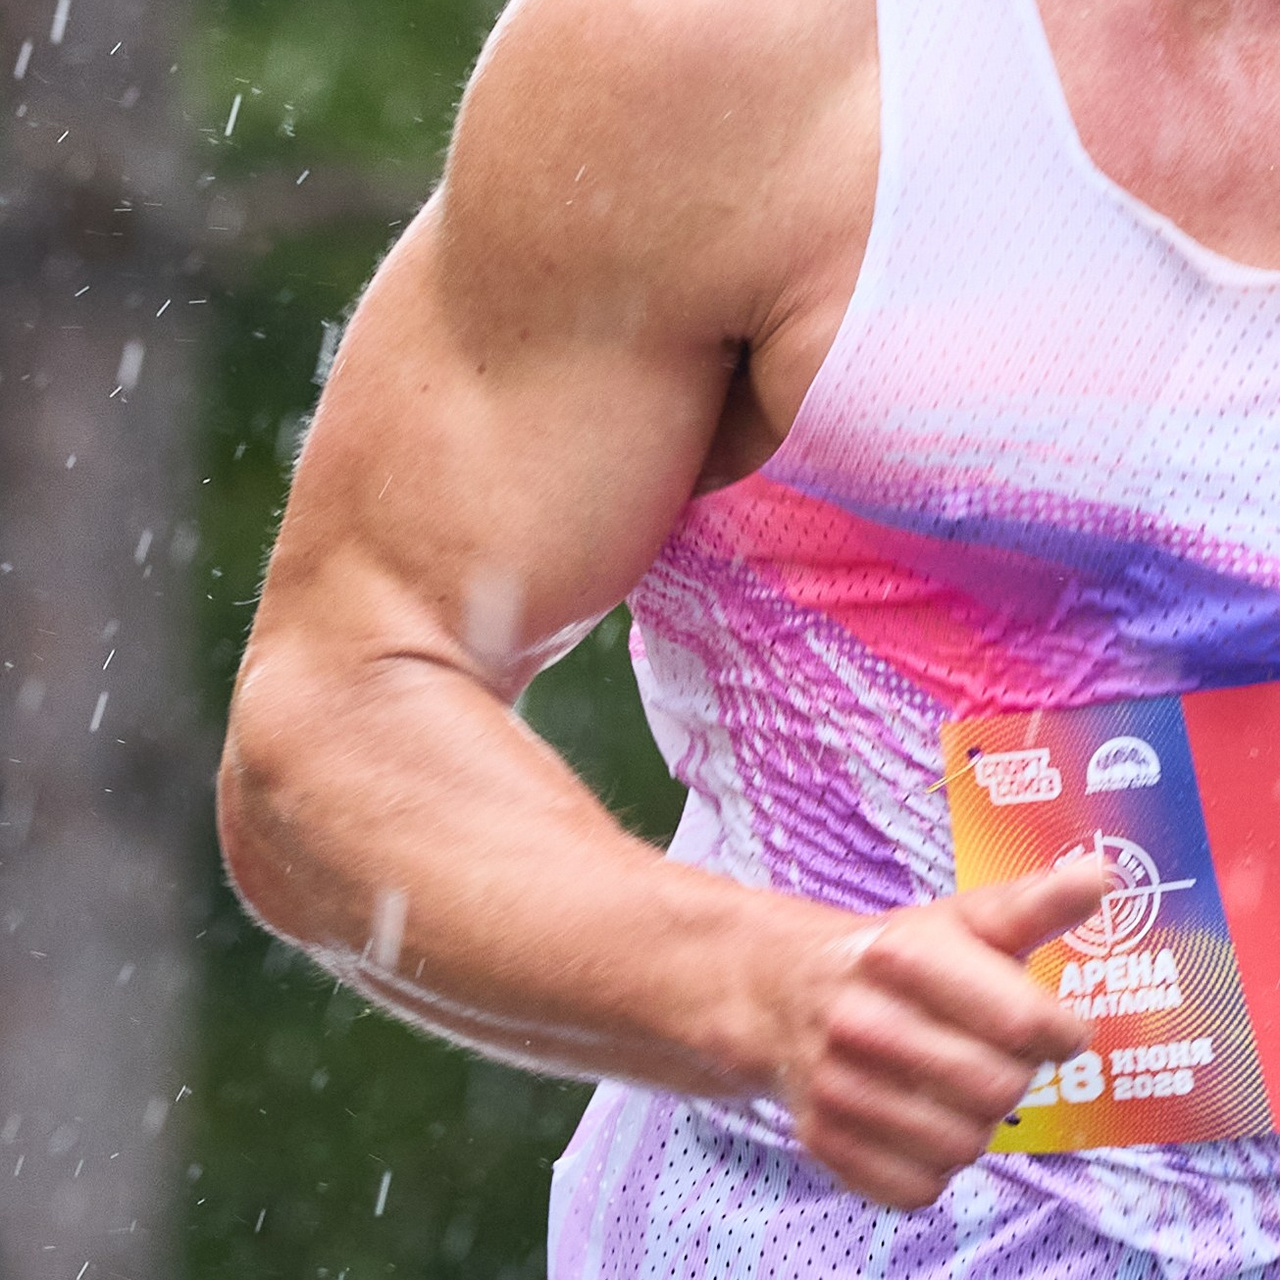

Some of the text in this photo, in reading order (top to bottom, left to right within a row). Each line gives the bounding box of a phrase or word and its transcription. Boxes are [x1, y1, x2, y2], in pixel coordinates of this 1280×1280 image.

[1058, 948, 1180, 999] АРЕНА
[1016, 1036, 1216, 1109] 28 ИЮНЯ
